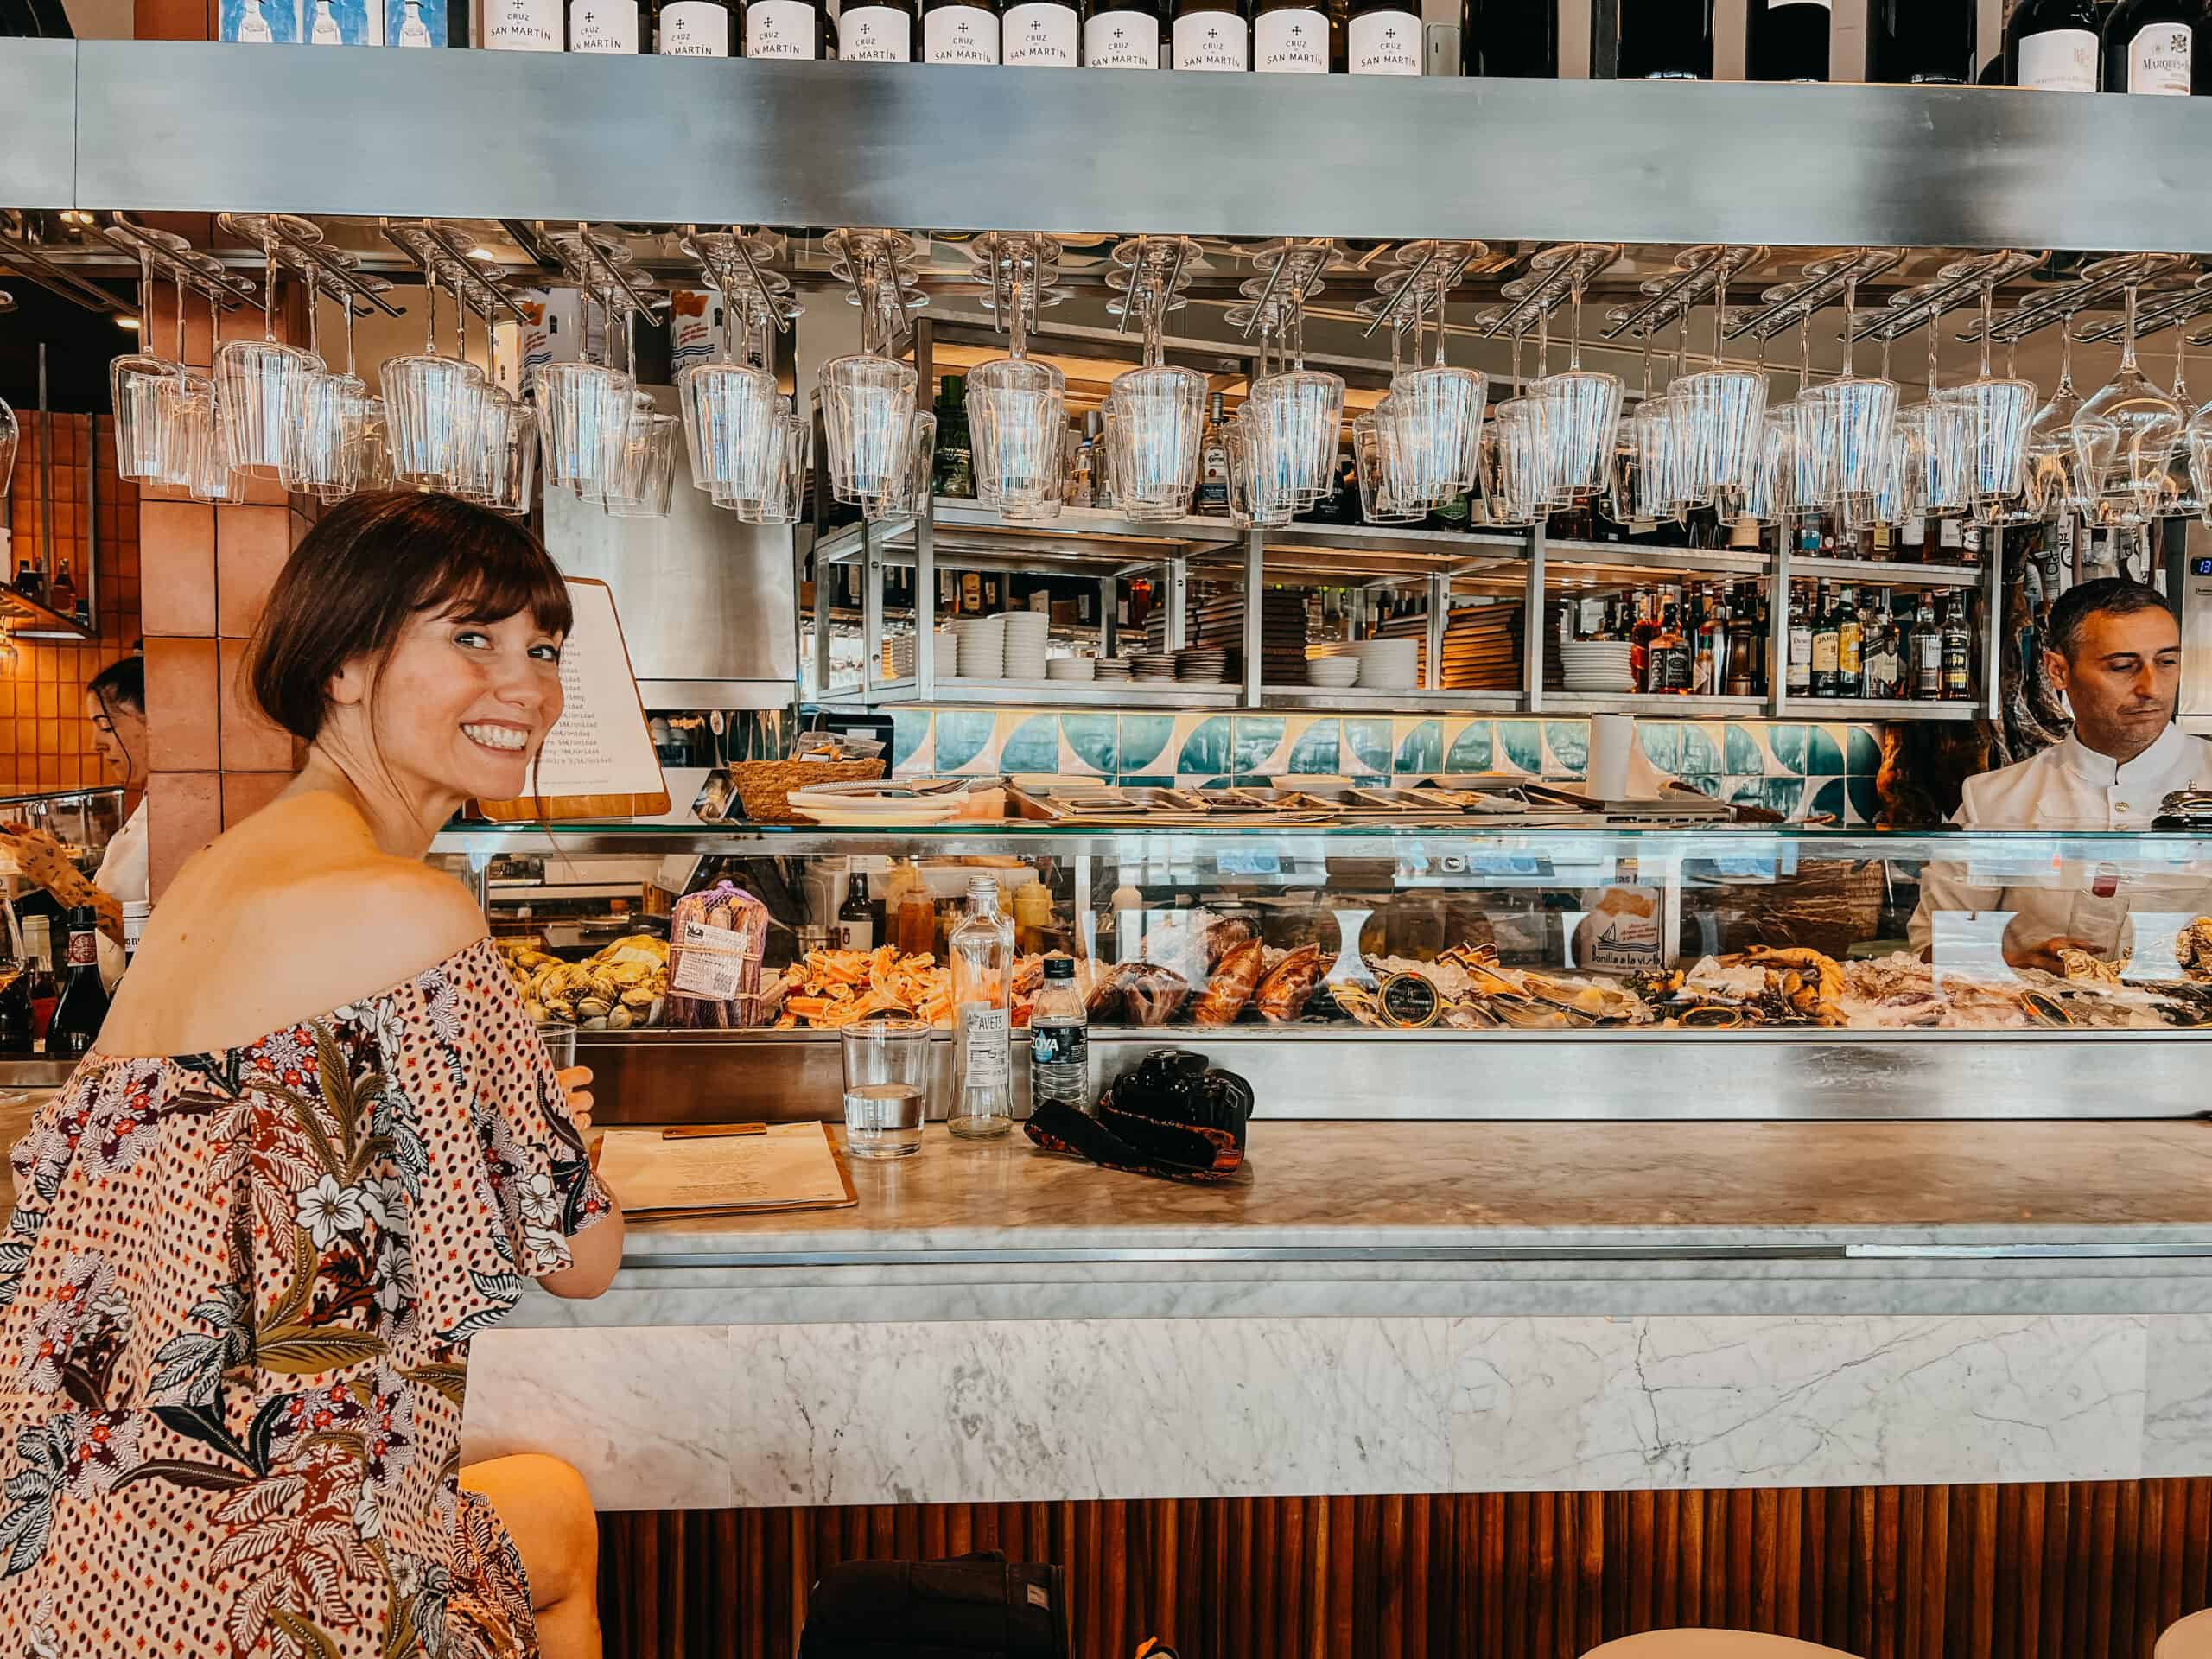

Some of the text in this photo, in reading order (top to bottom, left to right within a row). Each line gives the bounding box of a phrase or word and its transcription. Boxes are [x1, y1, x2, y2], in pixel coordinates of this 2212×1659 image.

[507, 13, 530, 22] CRUZ
[491, 27, 506, 36] SAN
[671, 33, 690, 41] CRUZ
[953, 37, 975, 46] CRUZ
[934, 50, 953, 60] SAN
[1009, 49, 1026, 61] SAN
[1267, 54, 1286, 65] SAN
[1091, 56, 1108, 69] SAN
[1183, 56, 1202, 67] SAN
[1361, 55, 1380, 67] SAN
